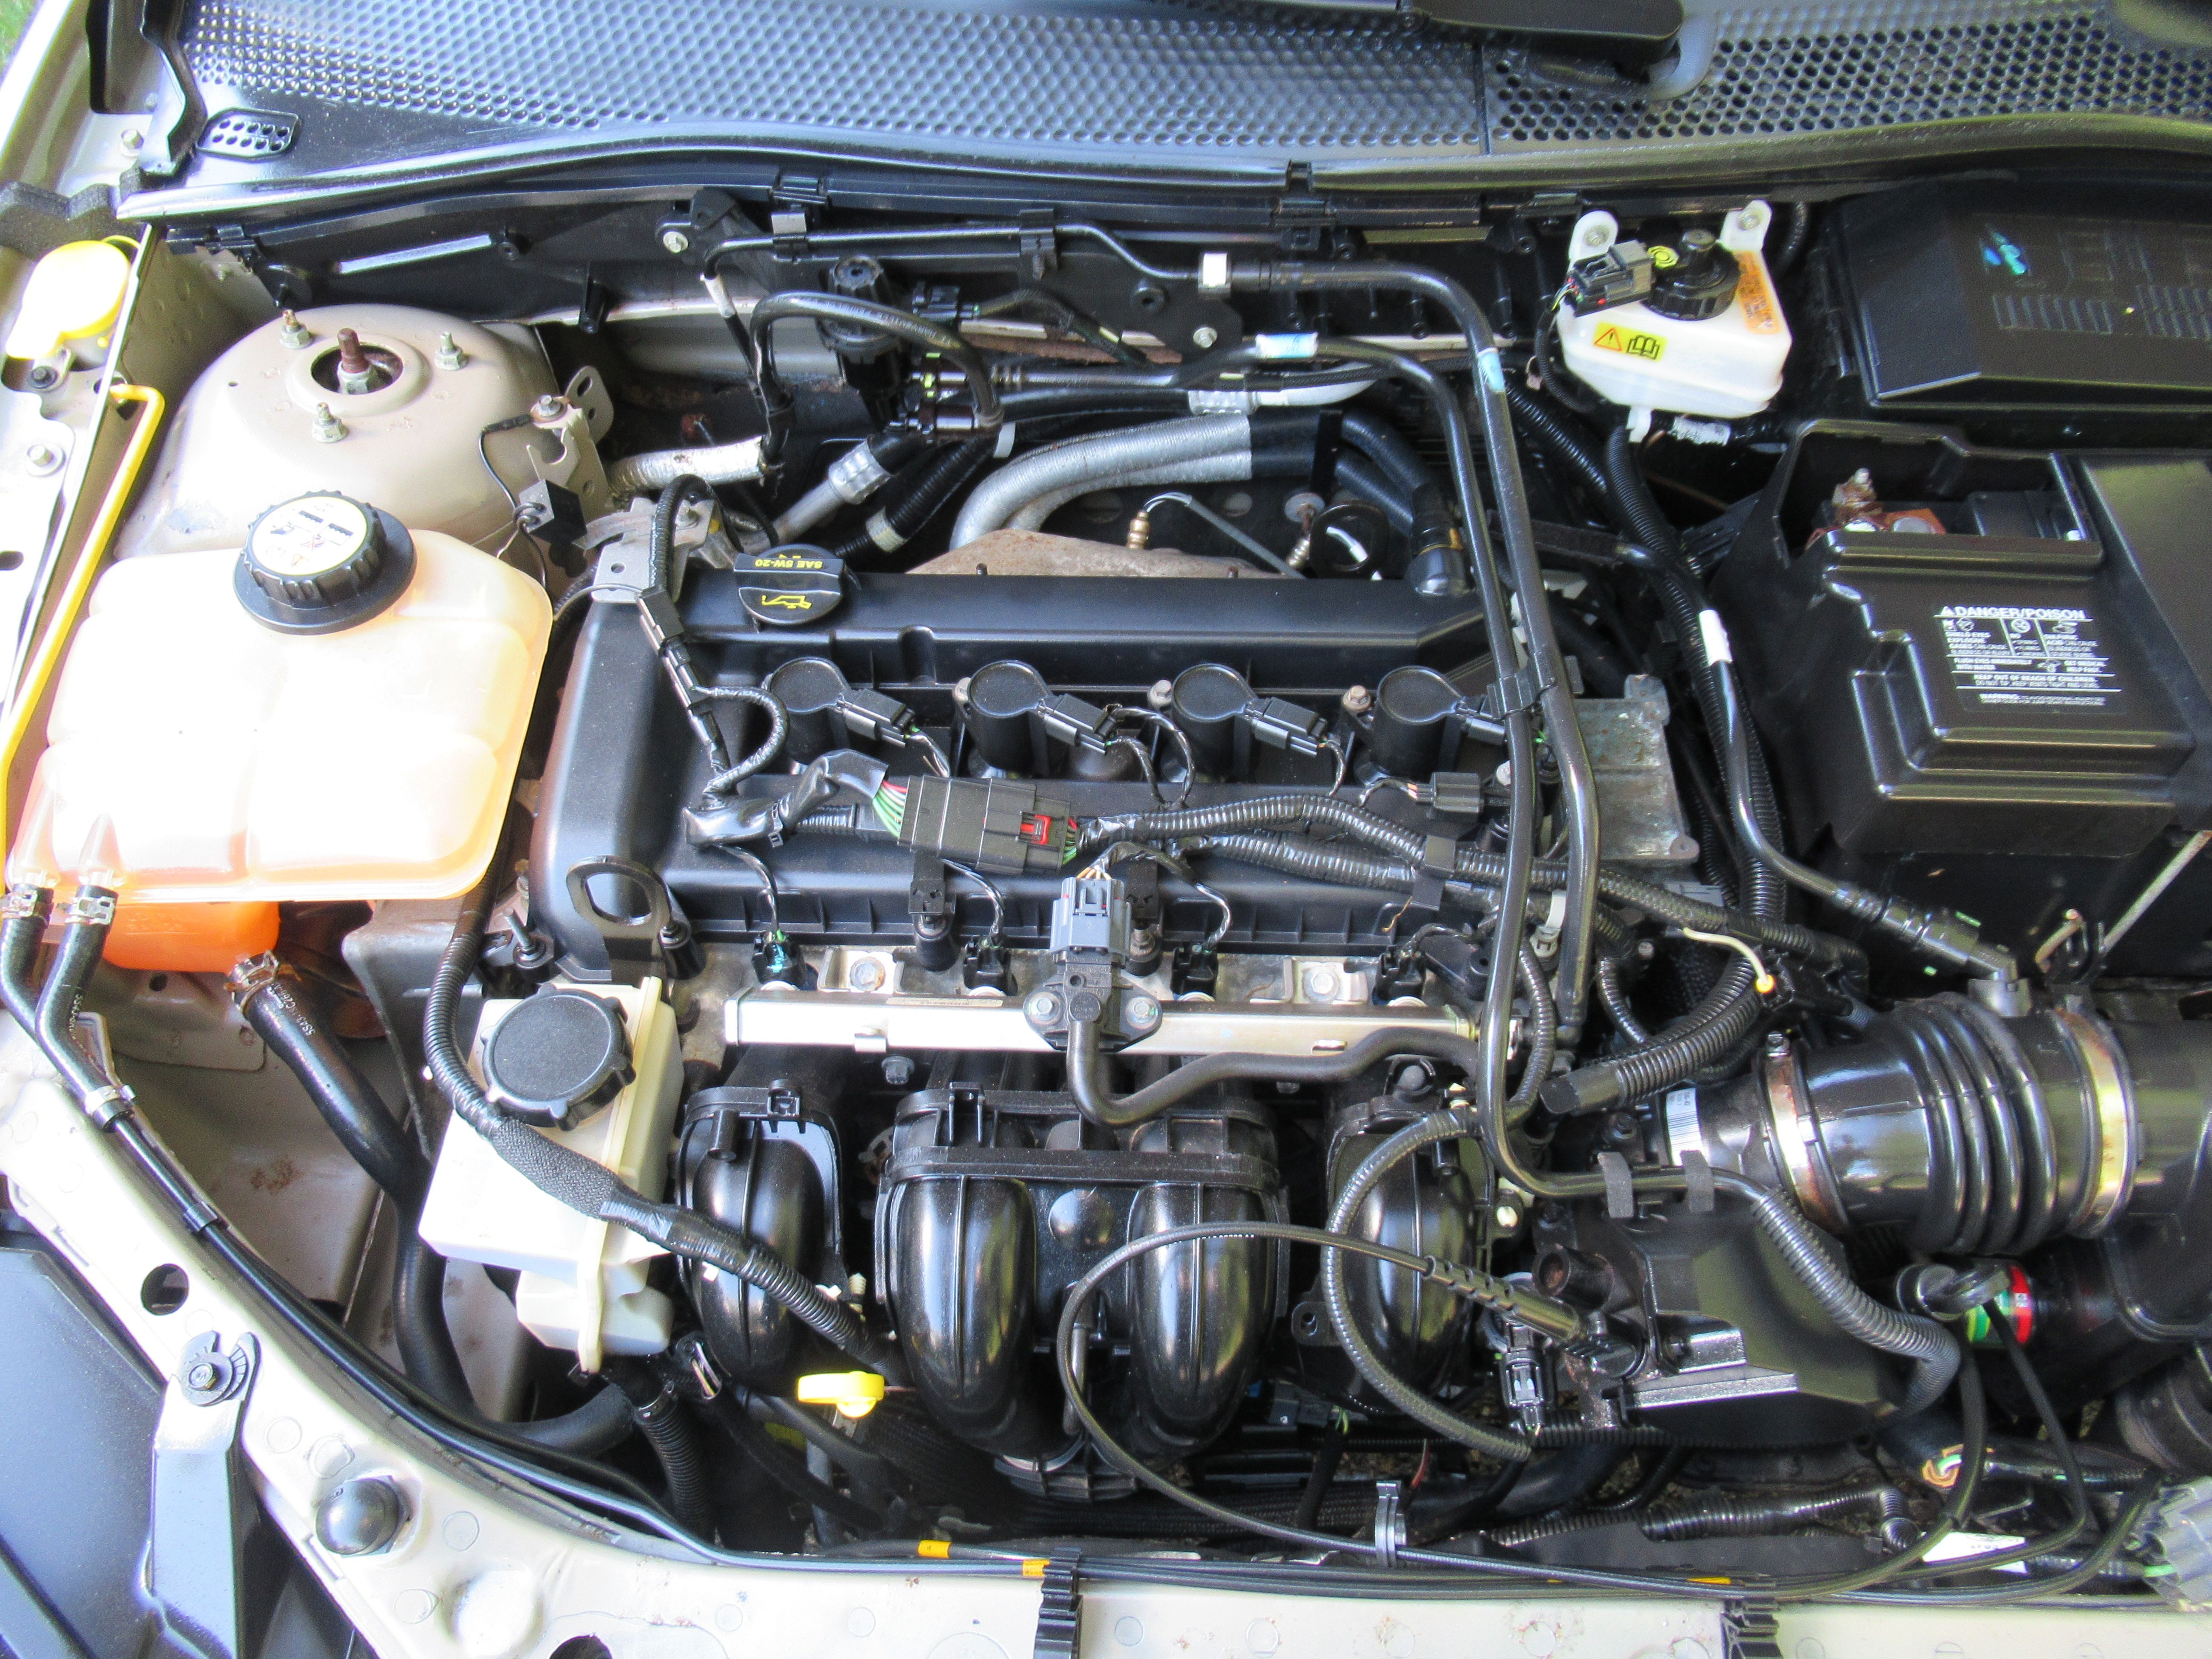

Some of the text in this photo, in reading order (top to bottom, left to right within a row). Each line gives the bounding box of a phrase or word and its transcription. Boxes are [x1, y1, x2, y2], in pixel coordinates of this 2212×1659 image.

[755, 559, 823, 569] SAE 5W-20
[1953, 606, 2087, 619] DANGER/POISON
